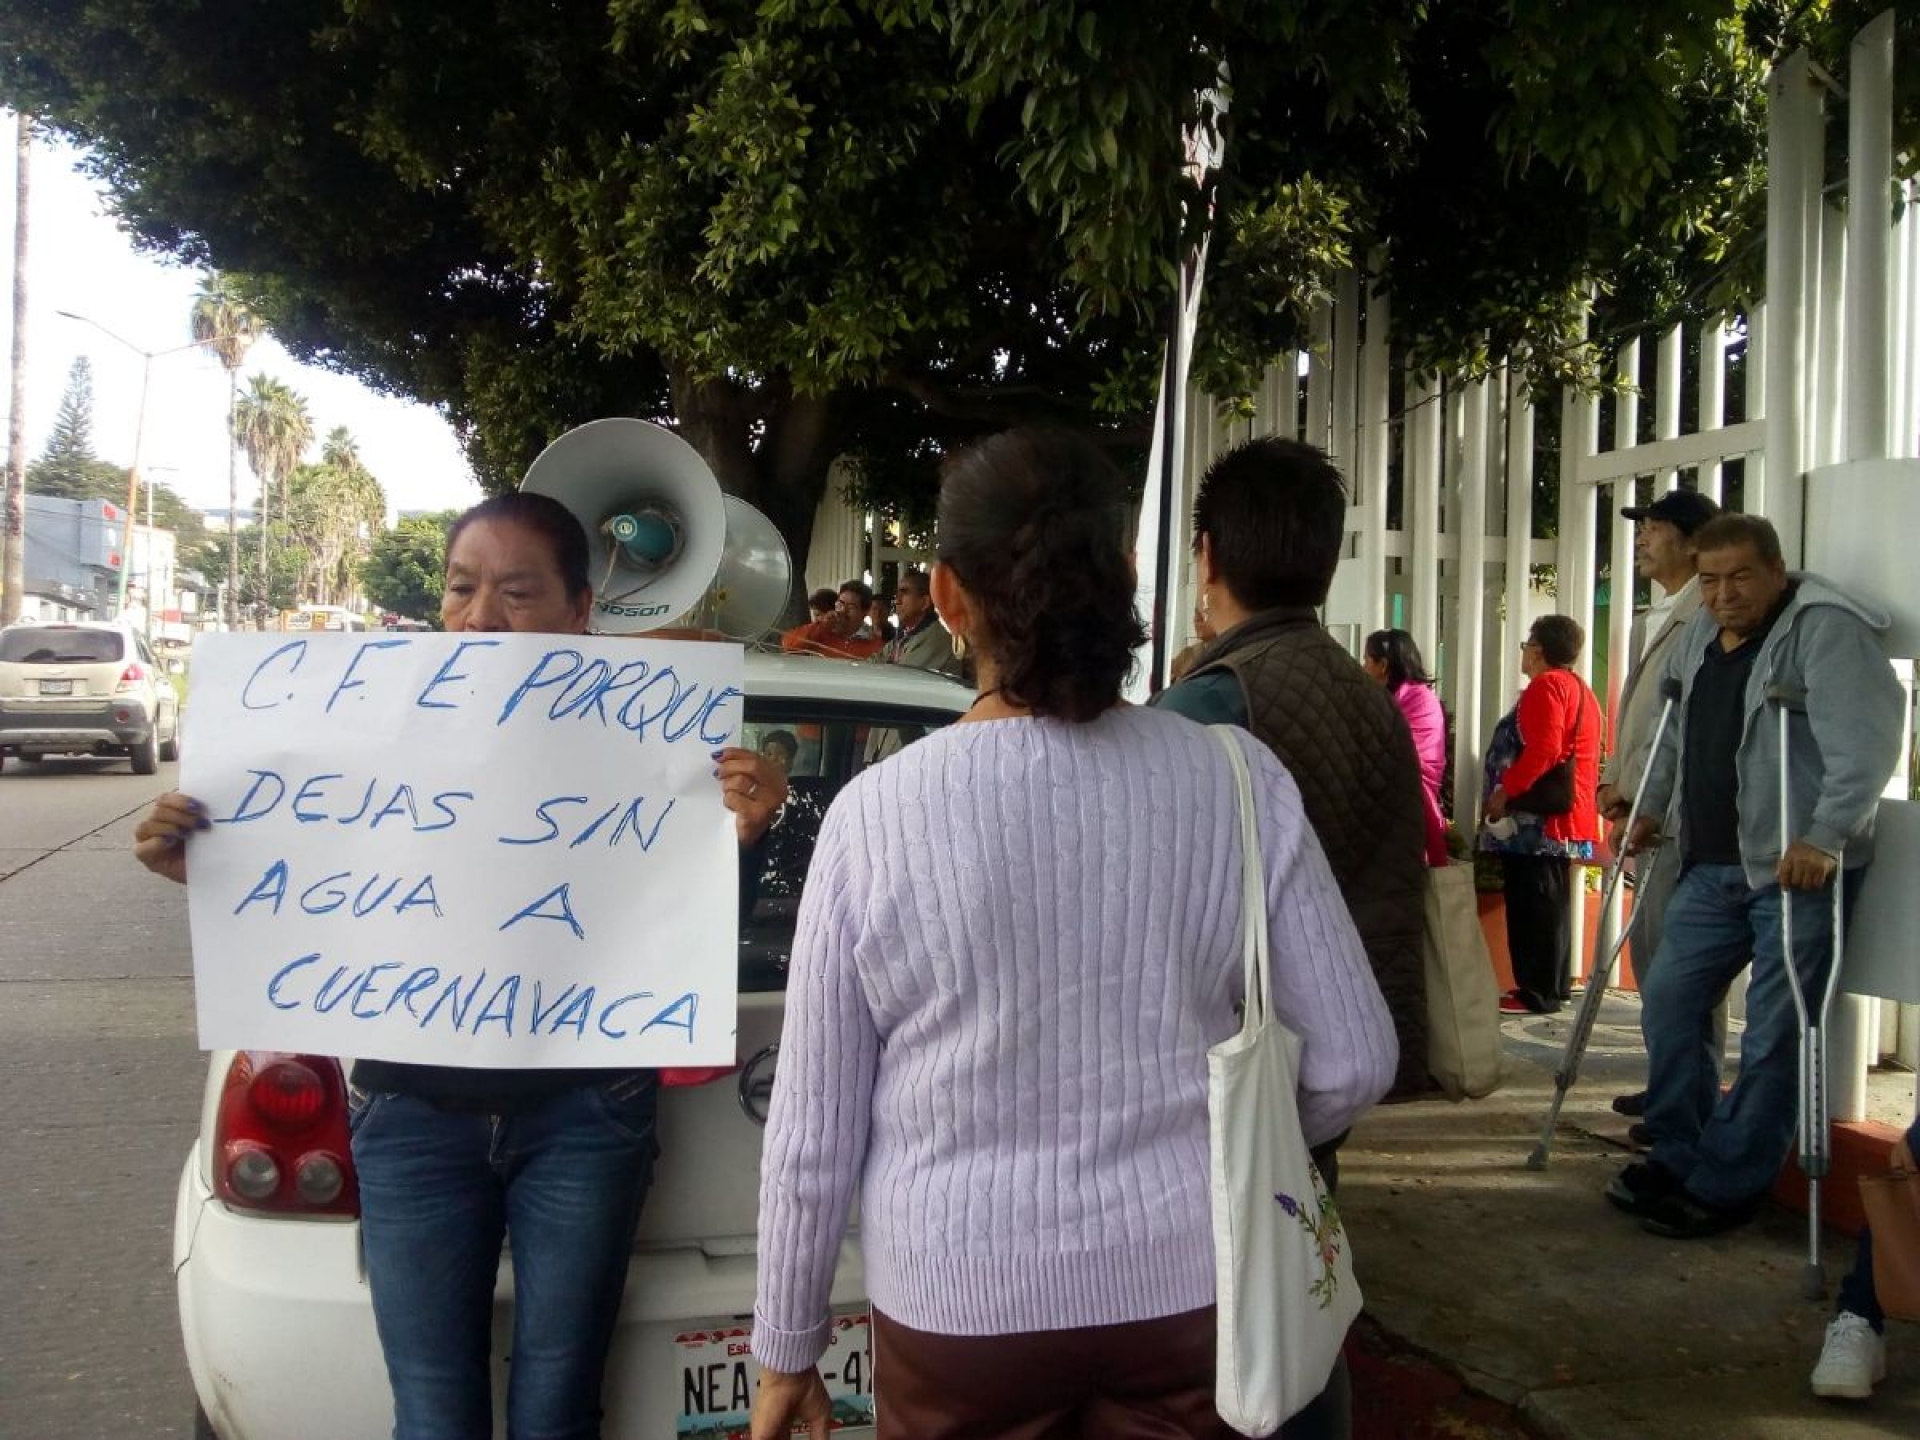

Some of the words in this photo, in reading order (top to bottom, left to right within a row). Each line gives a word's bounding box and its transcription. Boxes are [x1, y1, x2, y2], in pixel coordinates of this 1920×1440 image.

[498, 649, 744, 745] PORQUE
[213, 769, 474, 832] DEJAS
[498, 796, 676, 852] SIN
[233, 859, 444, 918] AGUA
[499, 882, 585, 940] A
